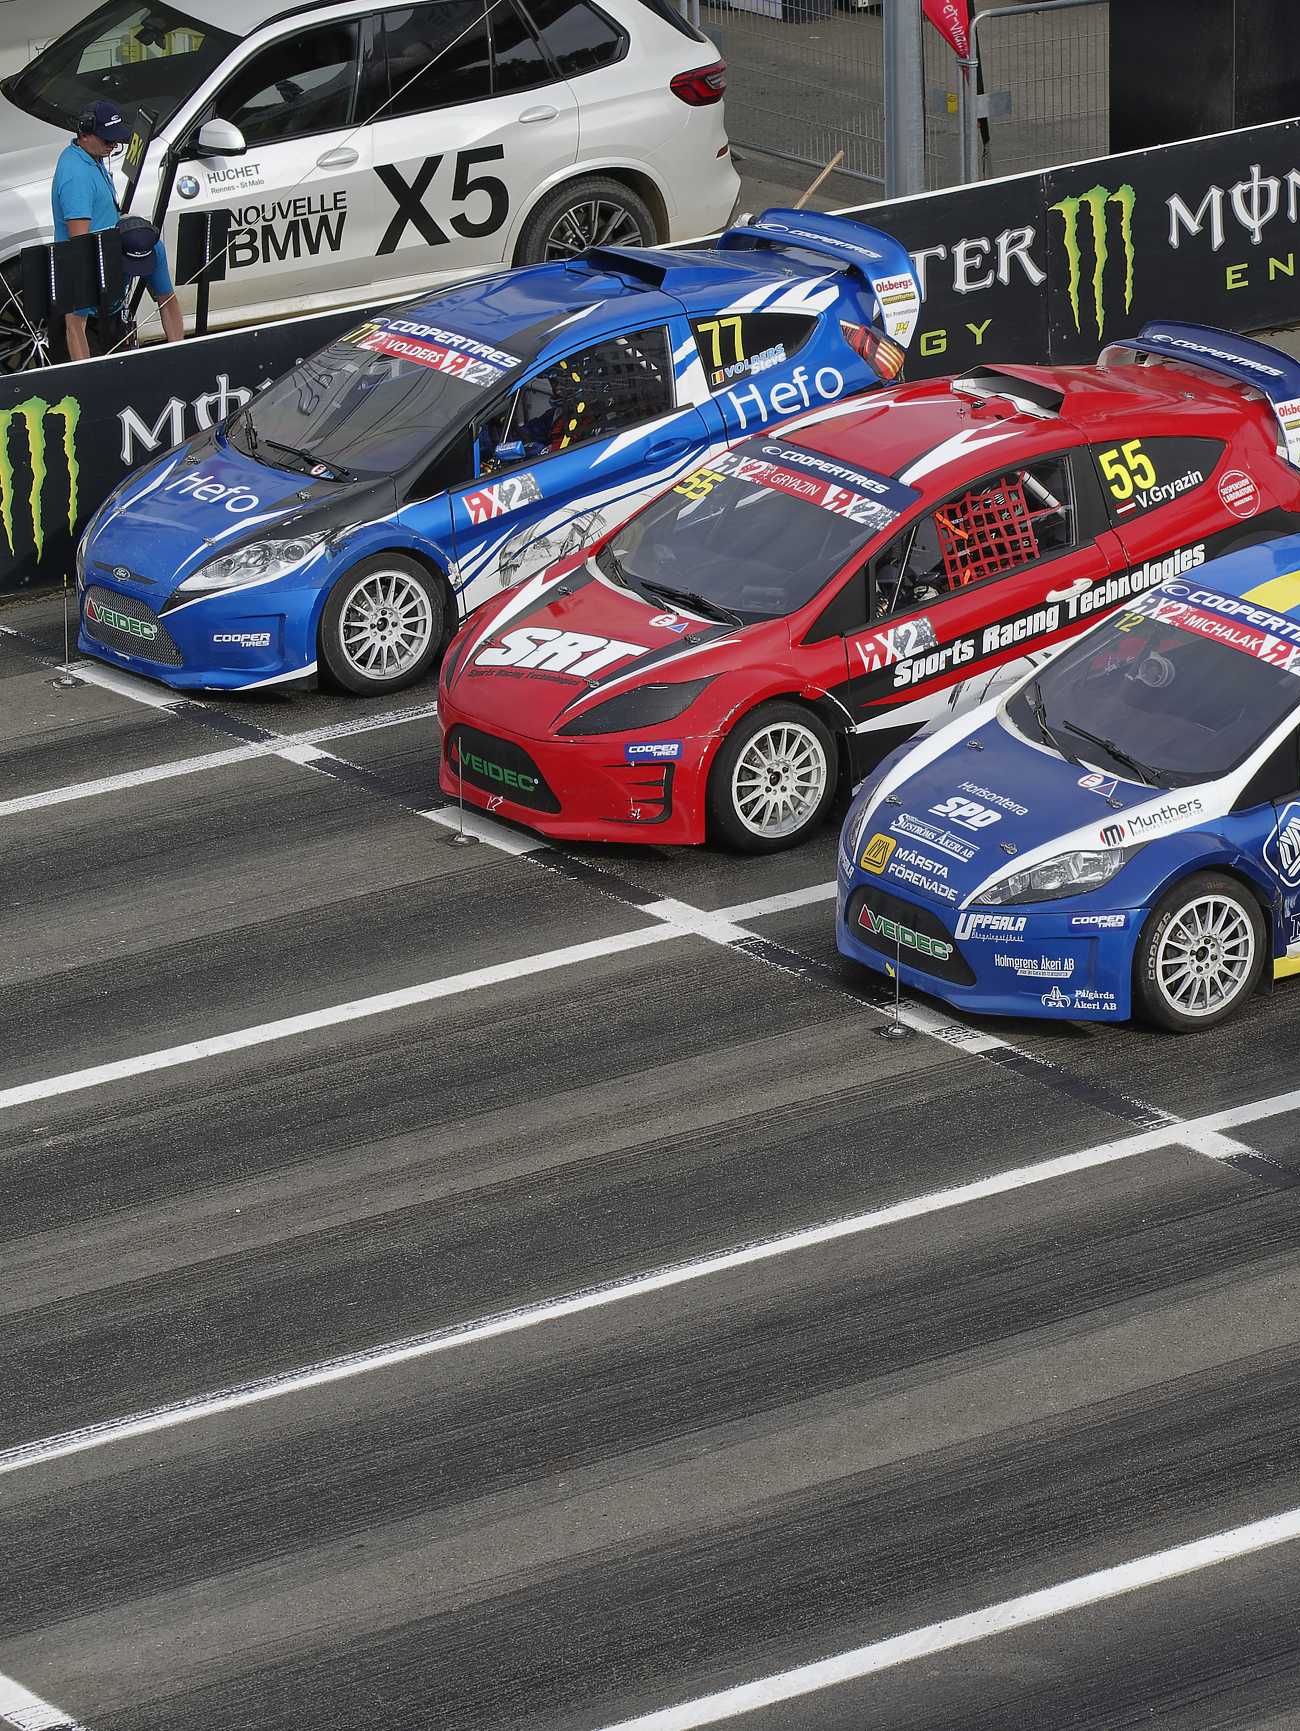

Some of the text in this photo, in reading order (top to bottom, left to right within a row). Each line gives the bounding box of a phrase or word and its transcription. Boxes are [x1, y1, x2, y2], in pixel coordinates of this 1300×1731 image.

[207, 164, 261, 184] HUCHET
[211, 185, 235, 195] Rennes
[249, 178, 265, 187] Malo
[230, 190, 347, 227] NOUVELLE
[373, 143, 509, 256] X5
[229, 211, 347, 269] BMW
[875, 279, 913, 293] Olsbergs
[386, 338, 445, 364] VOLDERS
[388, 319, 522, 368] COOPERTIRES
[697, 316, 745, 367] 77
[1171, 338, 1286, 377] COOPERTIRES
[728, 366, 844, 429] Hefo
[673, 468, 727, 500] 55
[770, 472, 822, 497] GRYAZIN
[780, 450, 891, 494] COOPERTIRES
[1099, 439, 1157, 500] 55
[165, 471, 260, 513] Hefo
[1135, 470, 1204, 508] V.Gryazin
[92, 602, 156, 641] VEIDEC
[893, 543, 1206, 688] Sports Racing Technologies
[1114, 613, 1145, 632] 12
[213, 632, 271, 643] COOPER
[240, 640, 270, 648] TIRES
[474, 627, 655, 678] SRT
[1185, 614, 1265, 656] MICHALAK
[628, 743, 679, 754] COOPER
[652, 749, 679, 757] TIRES
[460, 752, 535, 792] VEIDEC
[935, 796, 1002, 829] SPD
[958, 781, 1029, 817] Horisonterra
[1127, 799, 1202, 837] Munthers
[895, 847, 950, 879] MÄRSTA
[888, 863, 959, 901] FÖRENADE
[868, 910, 950, 960] VEIDEC
[954, 912, 1027, 941] UPPSALA
[1071, 914, 1127, 925] COOPER
[1098, 921, 1125, 929] TIRES
[994, 954, 1075, 971] Holmgrens Åkeri AB
[1074, 1001, 1117, 1011] Åkeri AB
